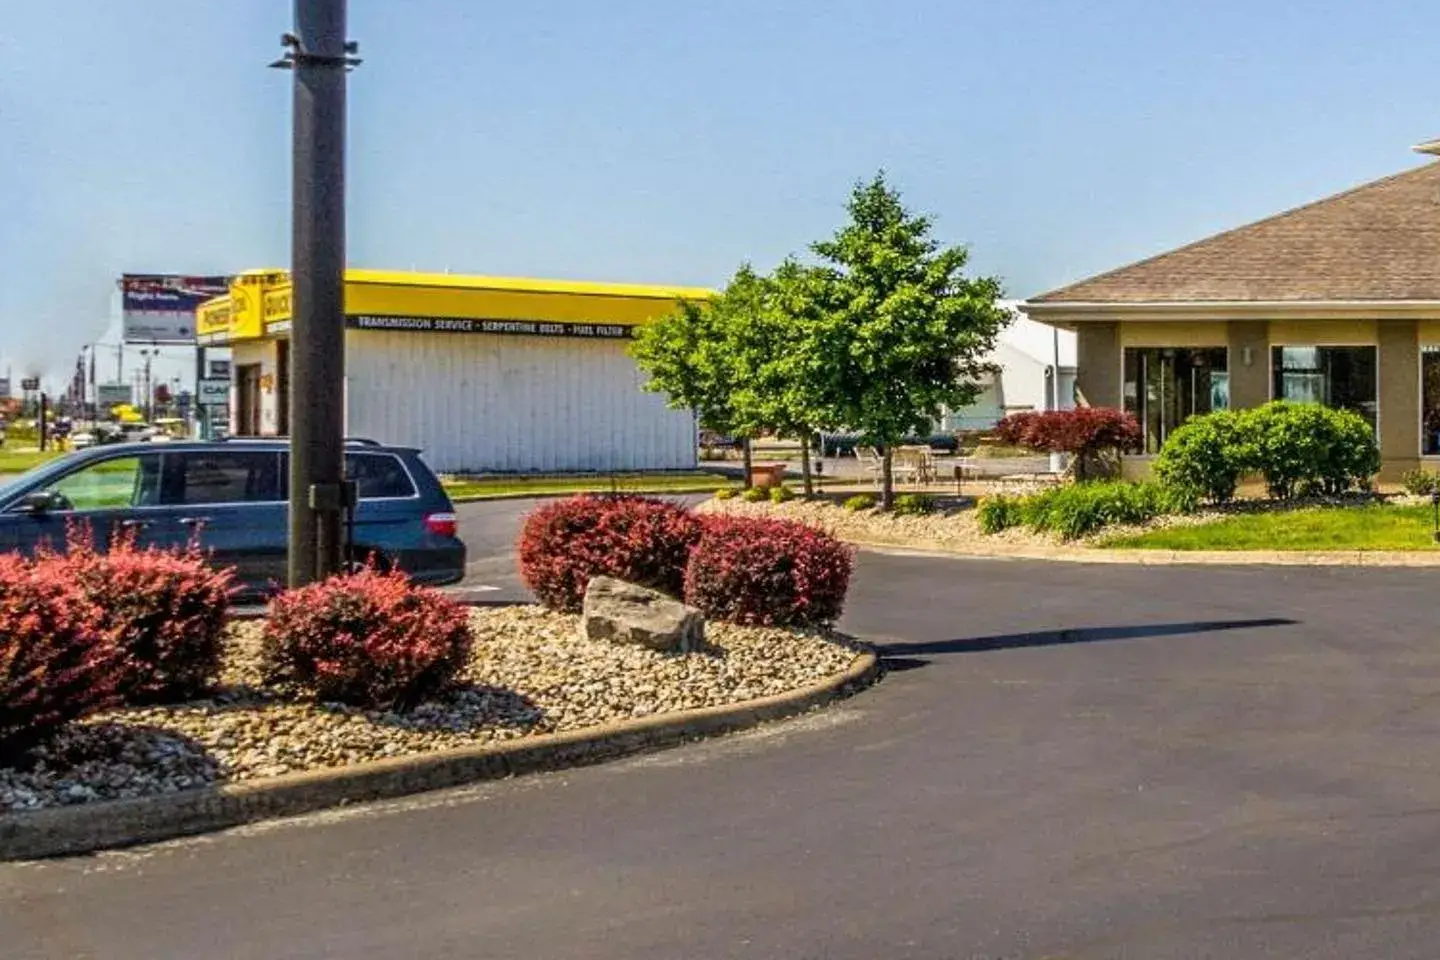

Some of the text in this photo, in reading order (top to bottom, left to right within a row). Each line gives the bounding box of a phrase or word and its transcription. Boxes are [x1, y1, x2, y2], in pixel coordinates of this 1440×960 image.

[359, 316, 431, 329] TRANSMISSION
[434, 319, 473, 331] SERVICE
[482, 320, 536, 333] SERPENTINE
